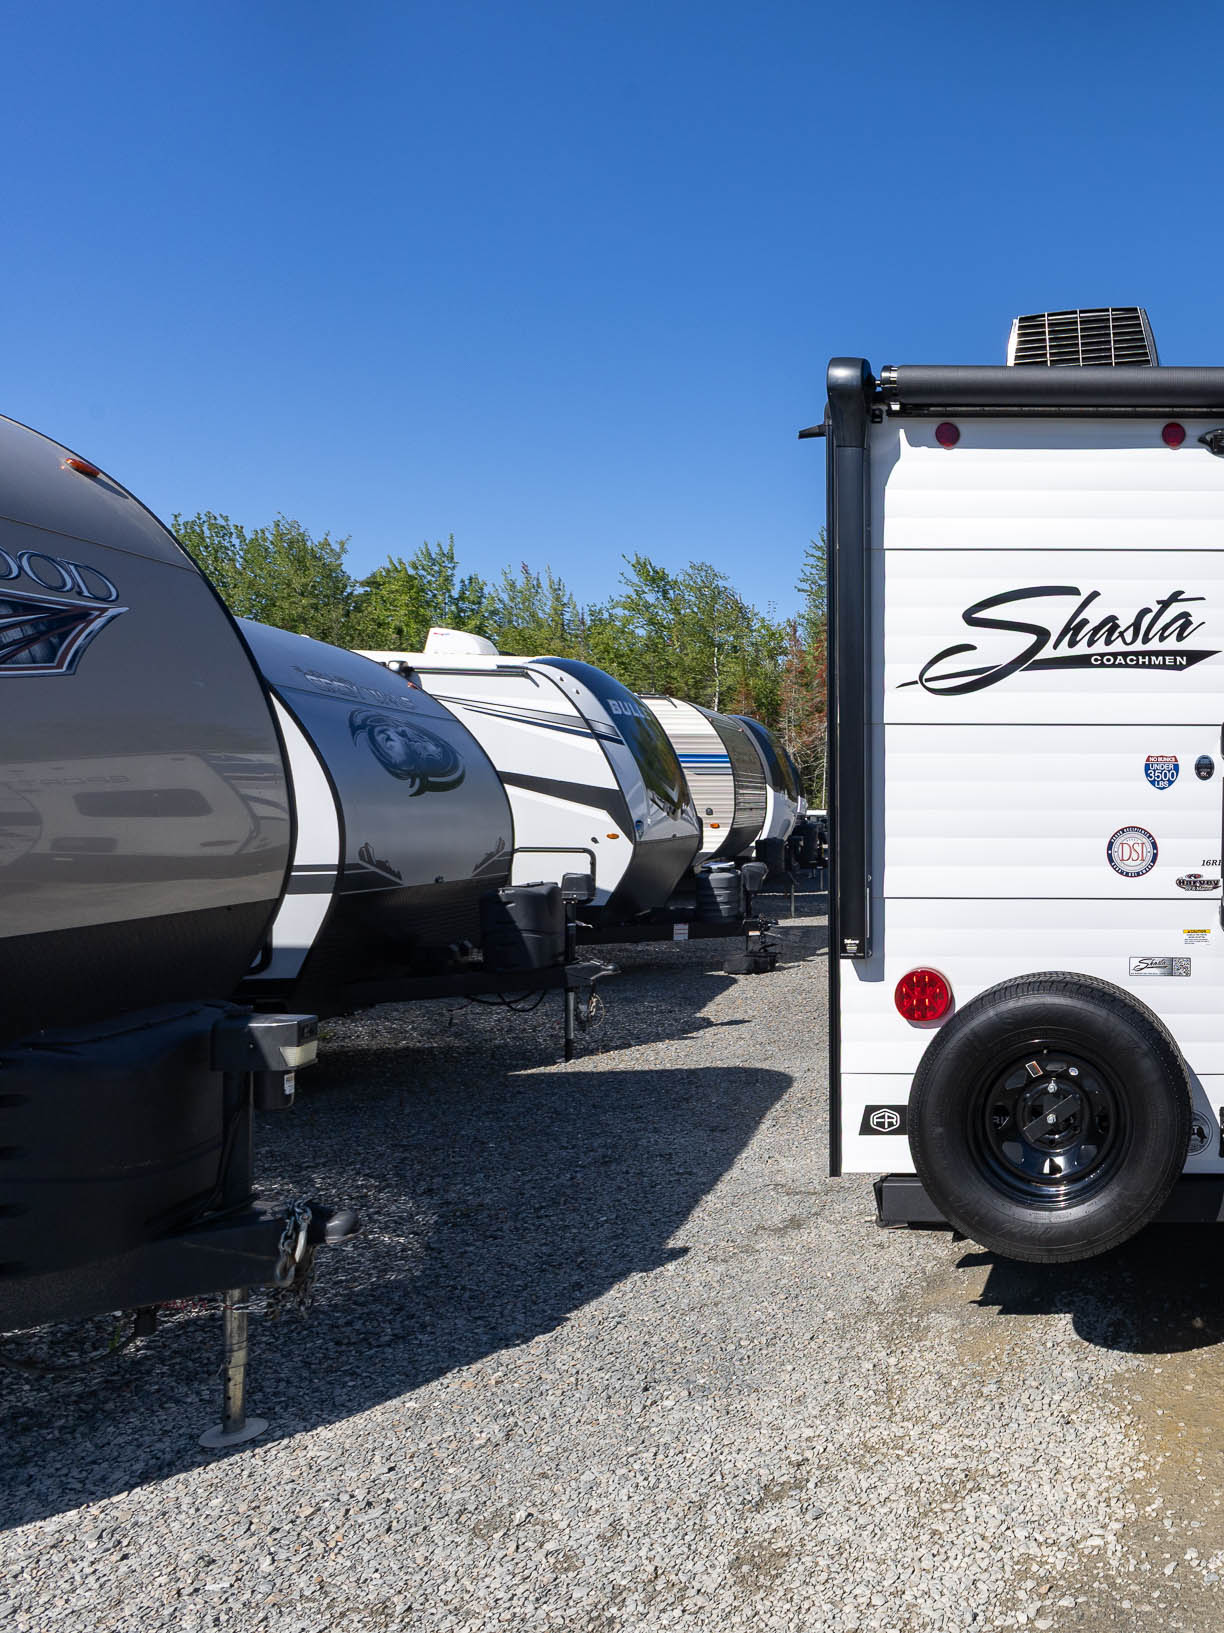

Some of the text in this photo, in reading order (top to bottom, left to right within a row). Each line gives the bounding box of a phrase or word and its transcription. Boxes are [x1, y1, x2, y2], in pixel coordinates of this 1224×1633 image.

[919, 586, 1206, 696] Shasta
[1091, 655, 1188, 666] COACHMEN
[1149, 763, 1174, 771] UNDER
[1147, 770, 1177, 781] 3500
[1155, 780, 1169, 788] LBS
[1120, 842, 1145, 861] DSI
